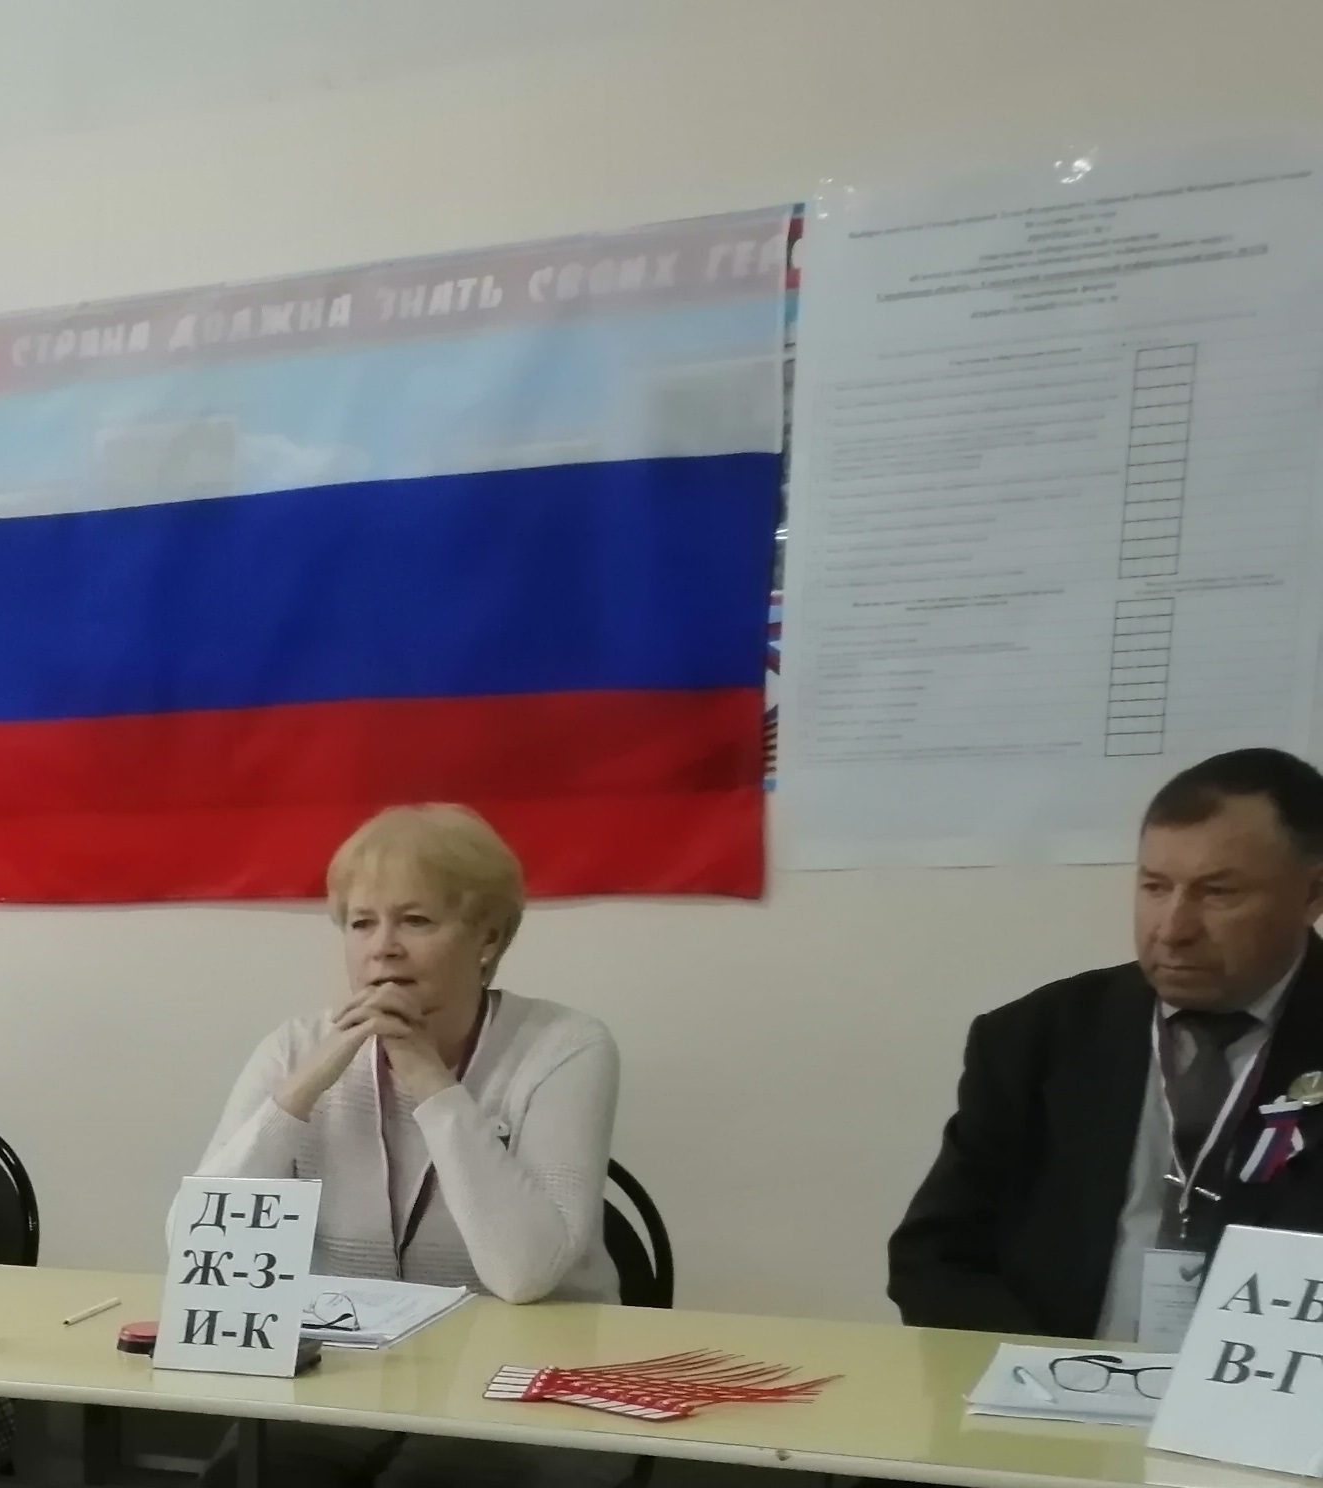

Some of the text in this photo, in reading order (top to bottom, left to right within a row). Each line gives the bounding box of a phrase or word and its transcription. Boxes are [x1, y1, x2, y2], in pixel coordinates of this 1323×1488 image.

[168, 294, 352, 354] ДОЛЖНА
[376, 275, 503, 321] ЗНАТЬ
[189, 1191, 300, 1237] Д-Е-
[178, 1250, 295, 1289] Ж-З-
[178, 1308, 279, 1350] И-К
[1204, 1339, 1323, 1395] В-Г
